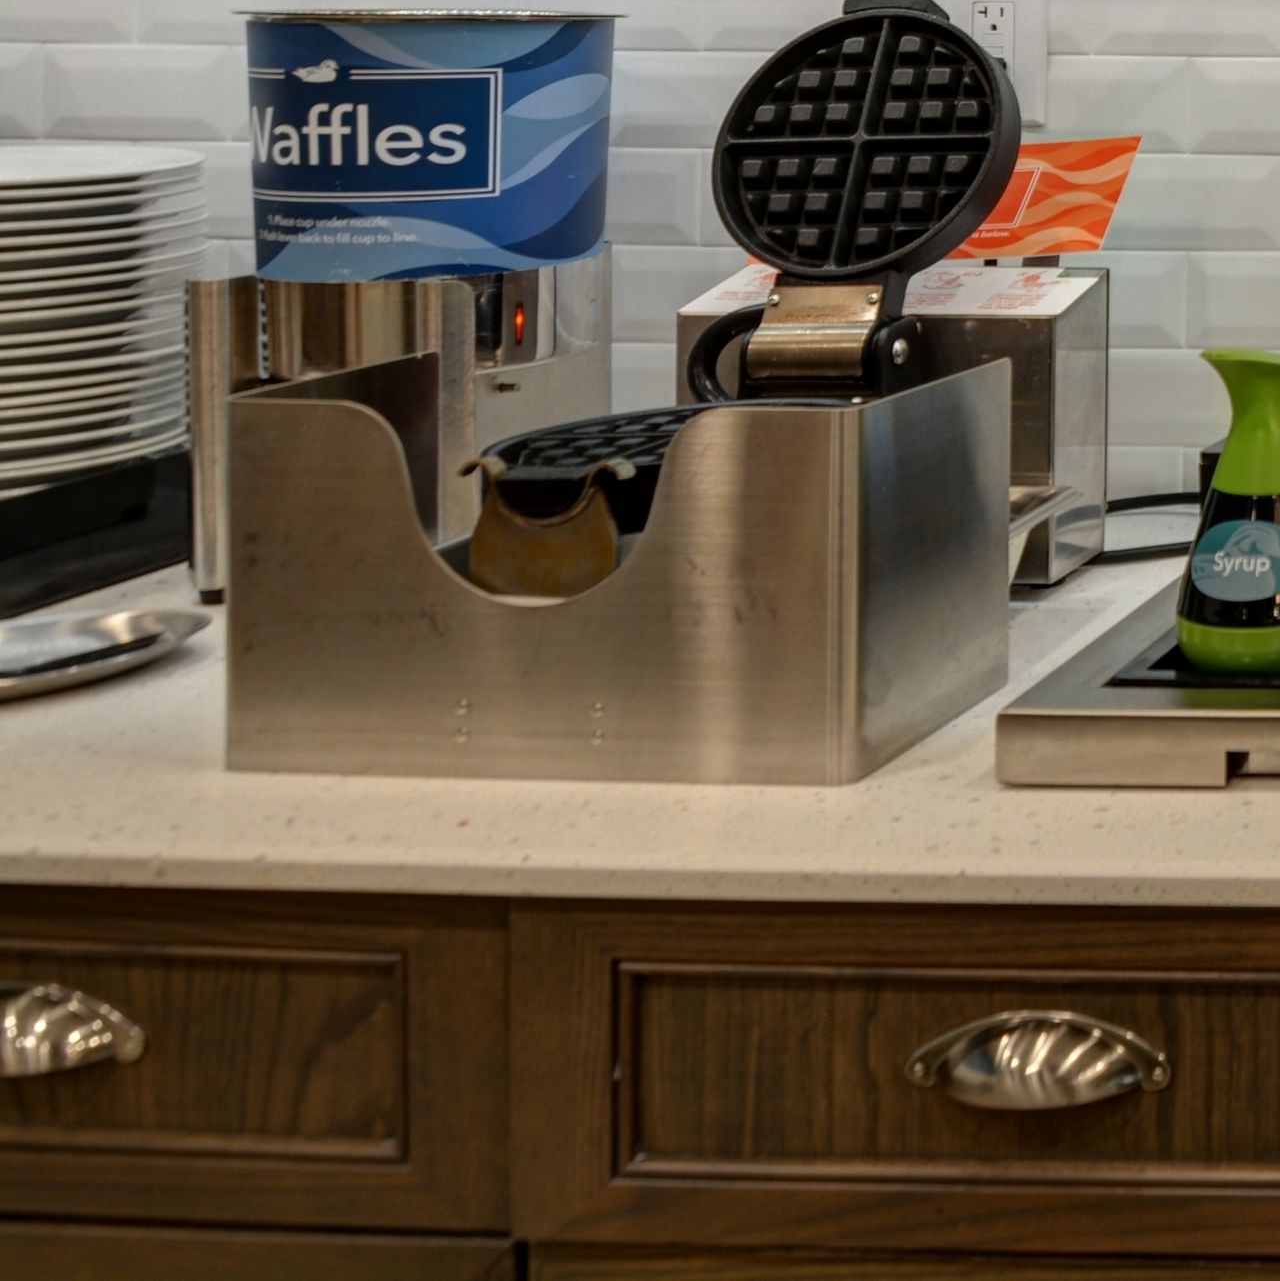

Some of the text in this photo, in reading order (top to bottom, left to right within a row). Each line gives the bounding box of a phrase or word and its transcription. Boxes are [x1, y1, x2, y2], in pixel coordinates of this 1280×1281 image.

[251, 103, 467, 166] Waffles
[316, 216, 349, 228] under
[323, 234, 336, 244] to
[336, 232, 351, 244] fill
[351, 234, 376, 246] cup
[377, 233, 391, 244] to
[1213, 550, 1272, 577] Syrup
